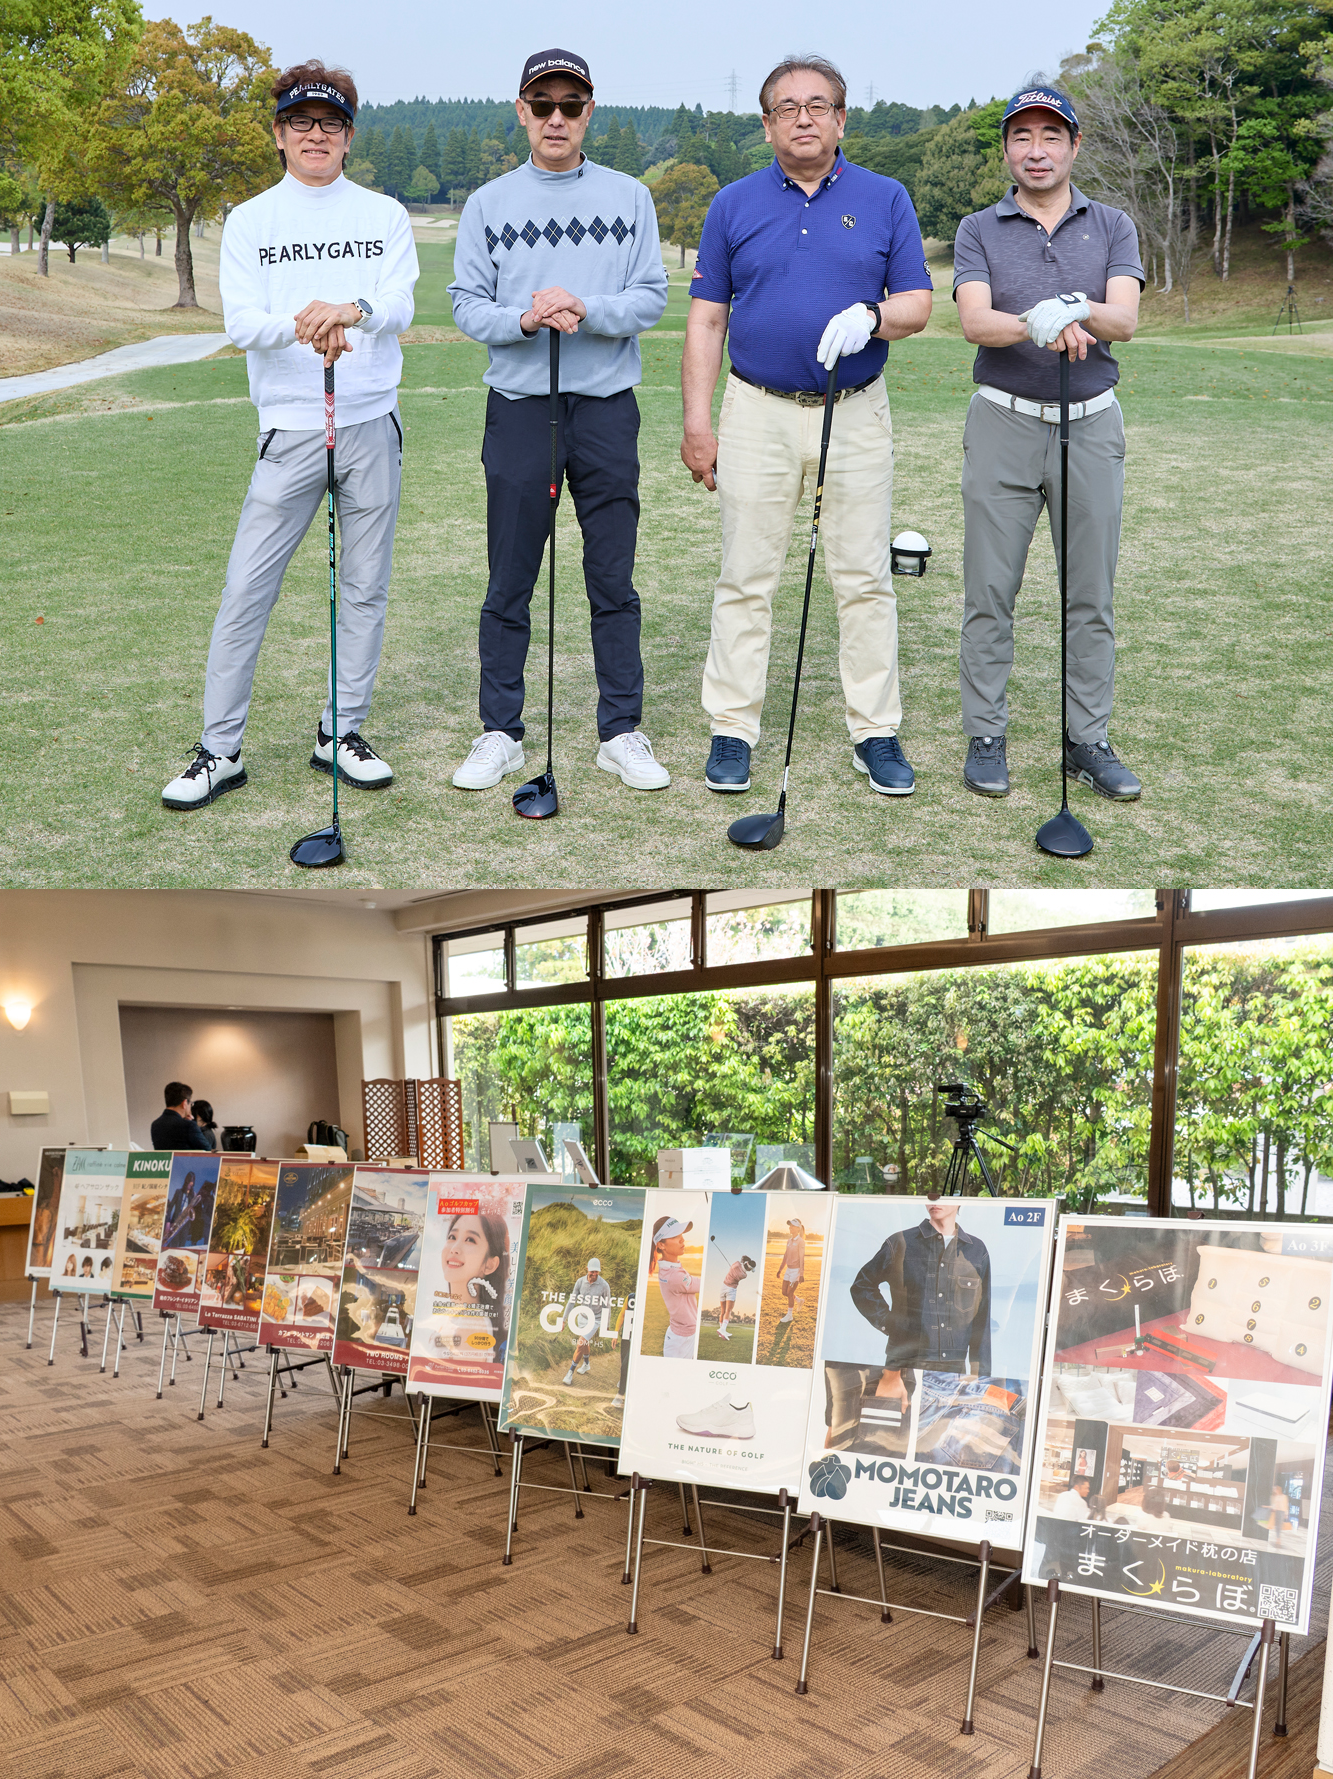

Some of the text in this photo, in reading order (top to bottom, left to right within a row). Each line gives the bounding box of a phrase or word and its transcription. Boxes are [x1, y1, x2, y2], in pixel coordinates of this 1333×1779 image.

[528, 59, 586, 76] new balance
[1014, 90, 1063, 108] Titleist
[259, 240, 384, 266] PEARLYGATES
[133, 1160, 173, 1172] KINOKU
[593, 1199, 613, 1207] ecco
[1008, 1211, 1042, 1223] Ao 2F
[1287, 1240, 1329, 1252] Ao 3F
[1065, 1264, 1184, 1306] まくらぼ
[541, 1291, 566, 1302] THE
[569, 1294, 624, 1308] ESSENCE
[539, 1303, 634, 1341] GOLF
[381, 1352, 403, 1361] ROOMS
[709, 1371, 737, 1381] ecco
[668, 1443, 685, 1451] THE
[688, 1445, 723, 1455] NATURE
[741, 1451, 765, 1460] GOLF
[854, 1458, 1018, 1501] MOMOTARO
[889, 1486, 973, 1519] JEANS
[1080, 1524, 1258, 1565] オーダーメイド枕の店
[1077, 1552, 1253, 1611] まくらぼ
[1175, 1565, 1253, 1583] makura-laboratory
